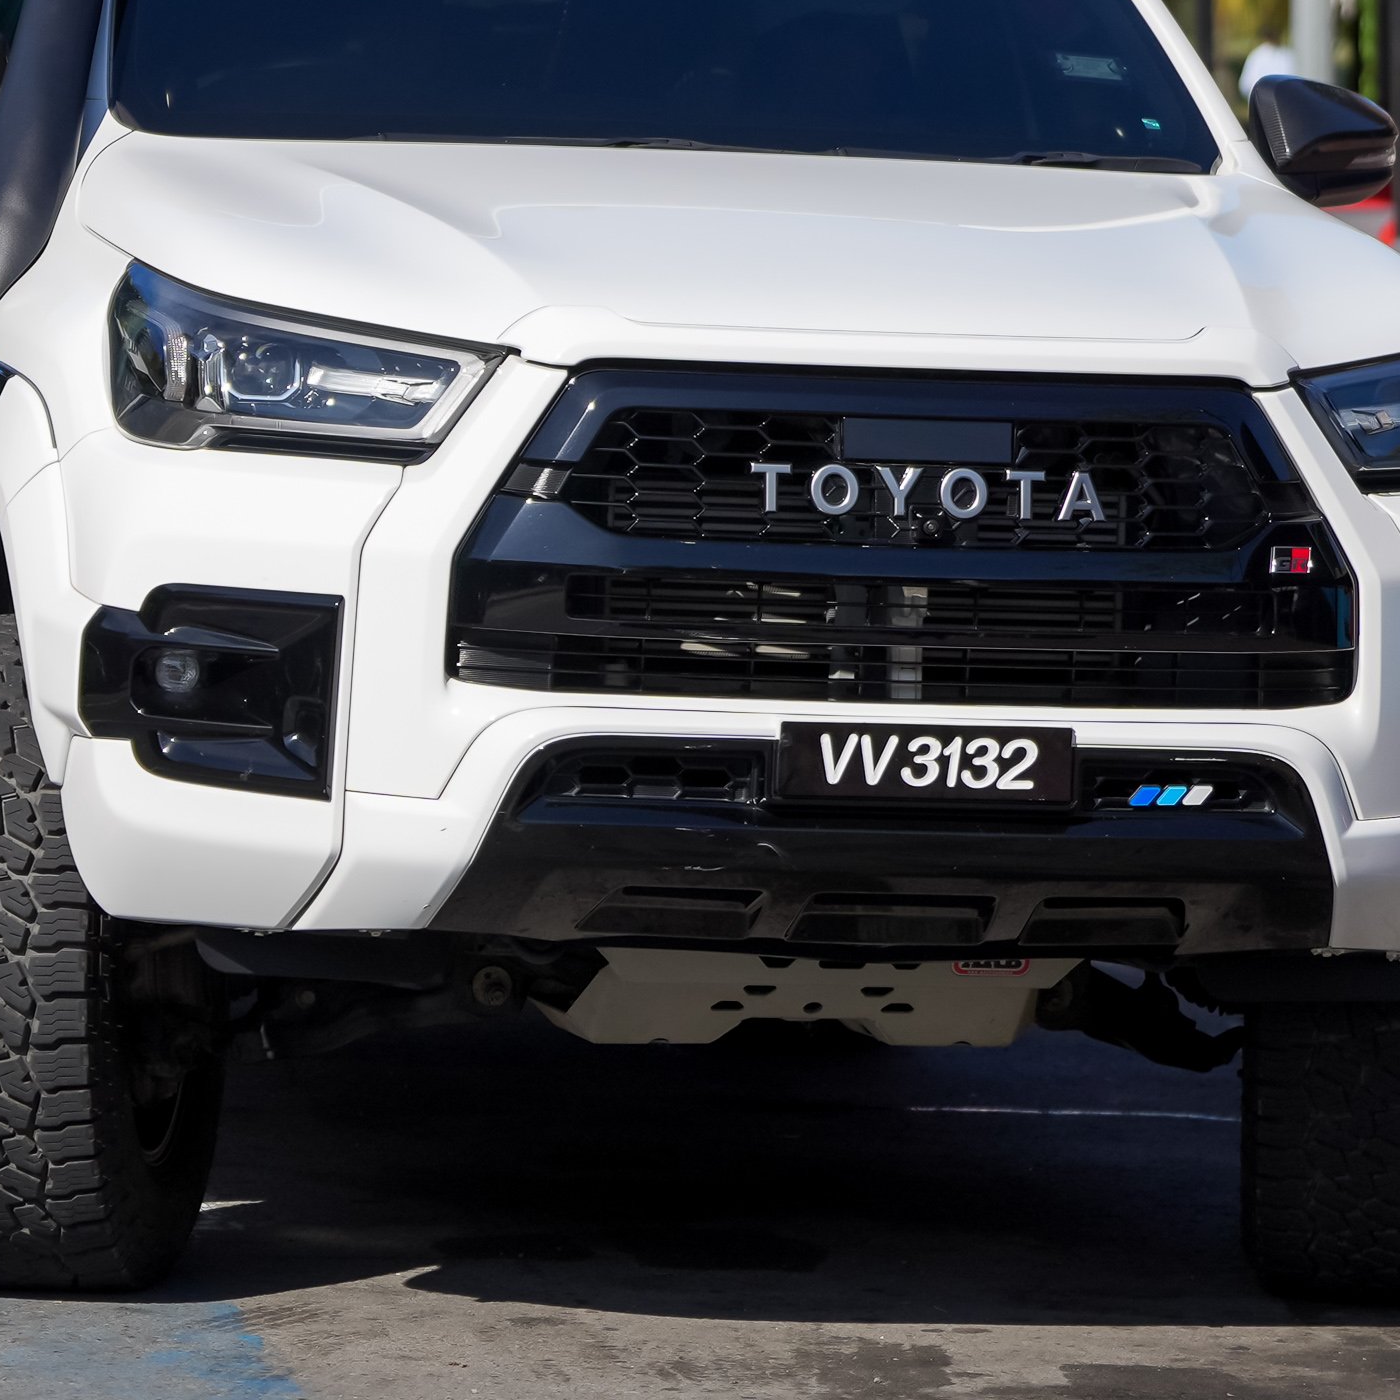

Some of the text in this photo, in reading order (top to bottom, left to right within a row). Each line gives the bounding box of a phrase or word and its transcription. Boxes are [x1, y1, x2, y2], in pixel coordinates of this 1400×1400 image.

[750, 462, 1106, 522] TOYOTA
[1275, 556, 1308, 572] GR
[820, 733, 1039, 790] VV 3132
